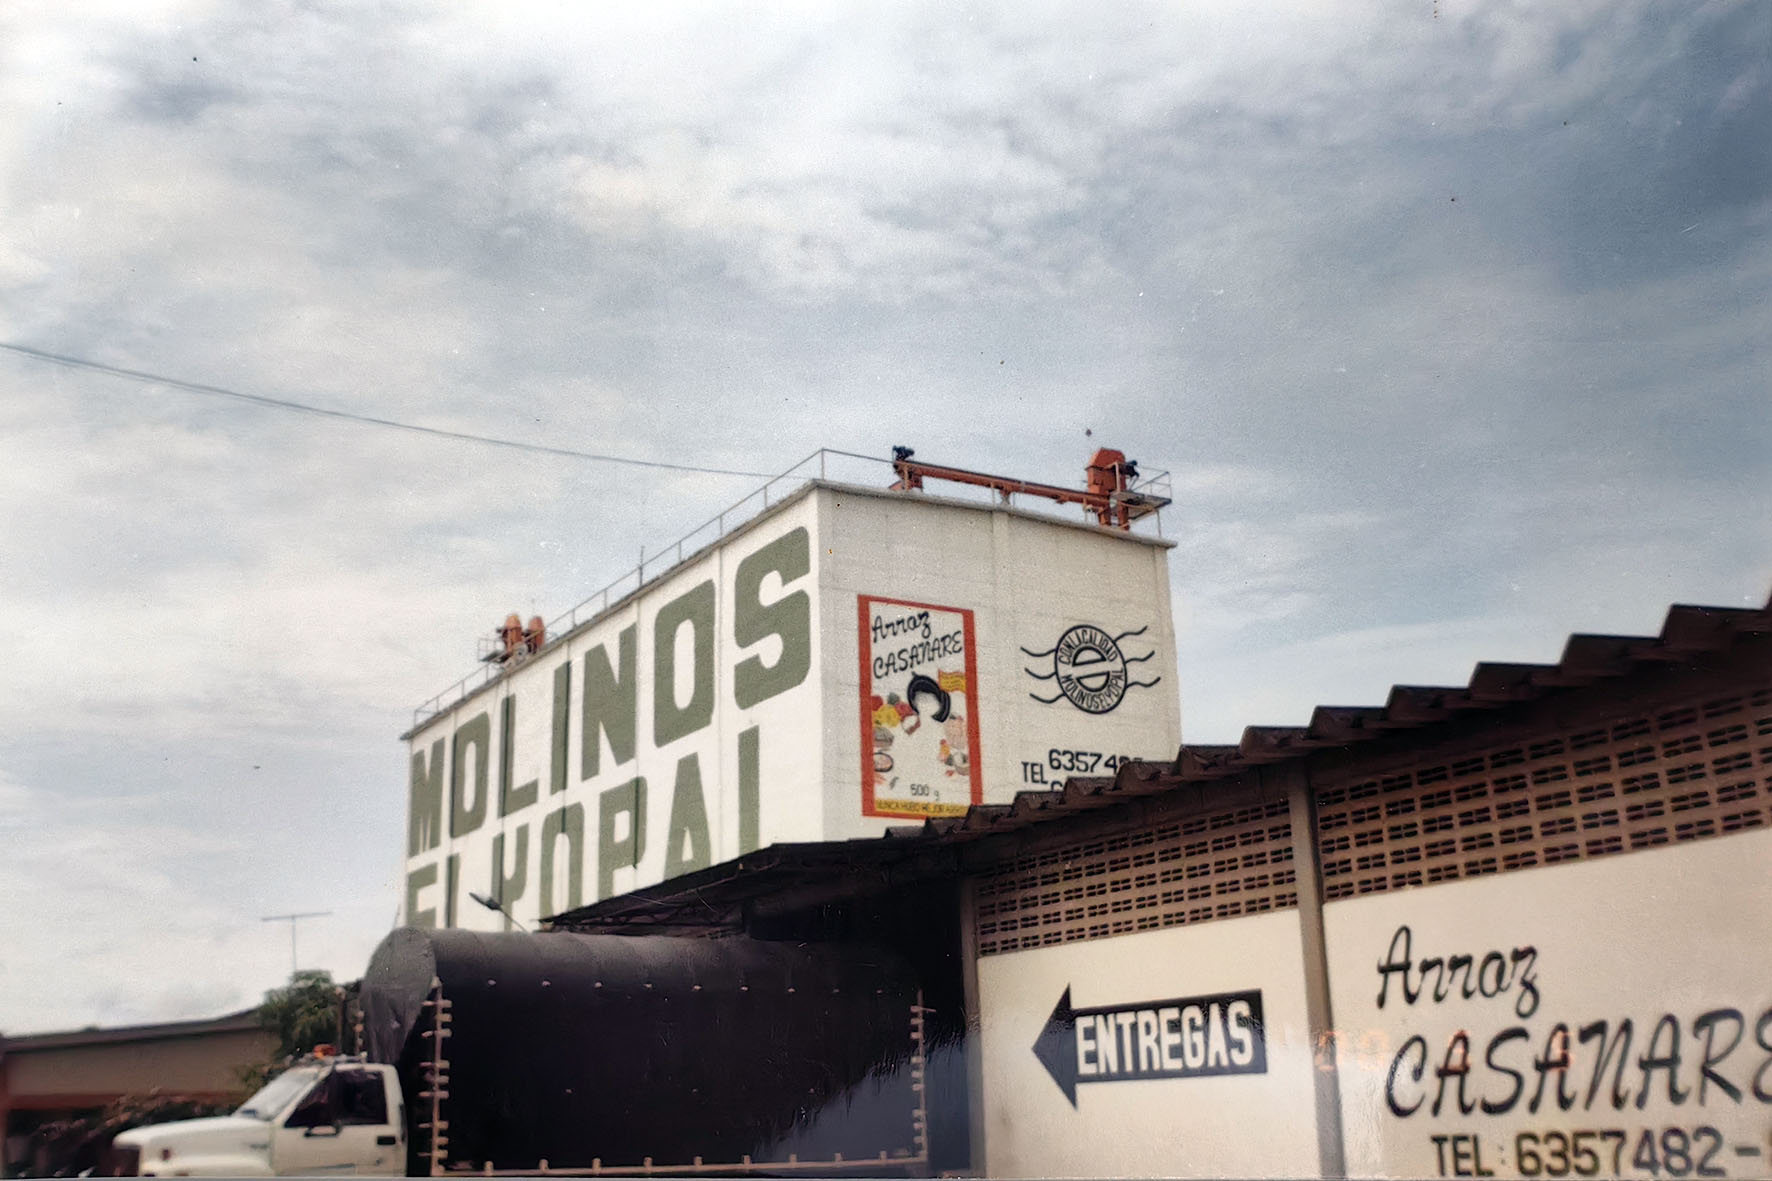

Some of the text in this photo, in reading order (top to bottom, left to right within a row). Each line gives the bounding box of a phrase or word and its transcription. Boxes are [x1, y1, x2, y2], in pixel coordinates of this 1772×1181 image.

[872, 610, 932, 644] Arroz
[872, 630, 963, 680] CASANARE
[409, 525, 812, 858] MOLINOS
[910, 783, 930, 797] 500
[1021, 748, 1144, 785] TEL 63574
[1376, 924, 1541, 1019] Arroz
[1075, 999, 1255, 1076] ENTREGAS
